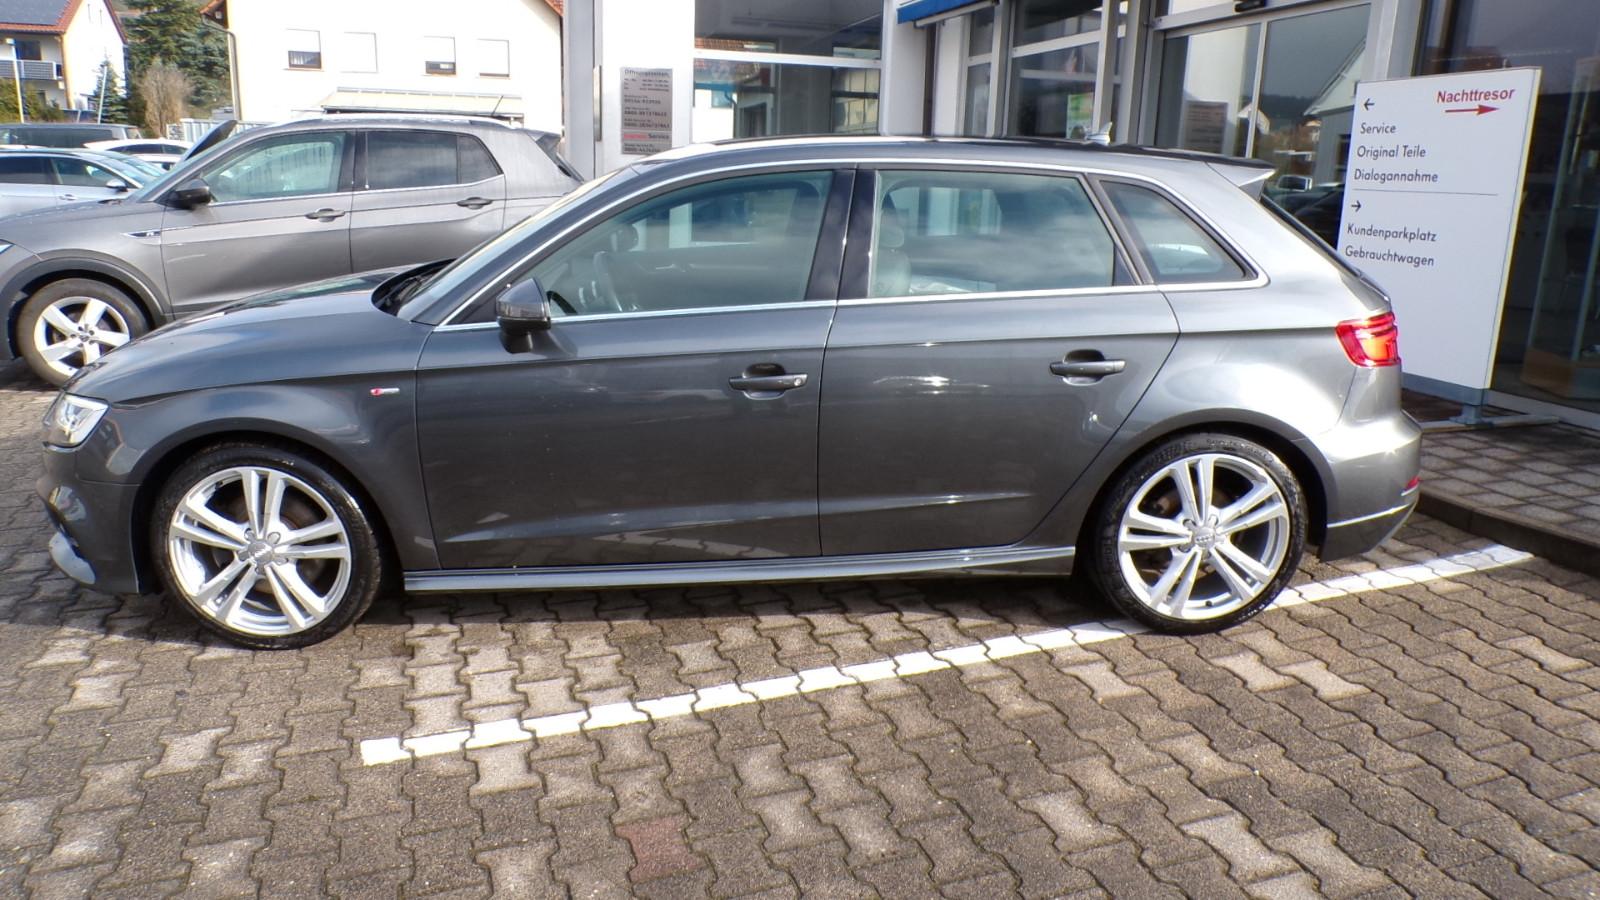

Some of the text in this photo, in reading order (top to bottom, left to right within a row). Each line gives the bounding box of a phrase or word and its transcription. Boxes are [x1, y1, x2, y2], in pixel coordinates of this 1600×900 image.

[1436, 88, 1516, 103] Nachttresor
[1360, 122, 1396, 134] Service
[1357, 144, 1426, 160] Original Teile
[1354, 168, 1438, 183] Dialogannahme
[1347, 223, 1437, 243] Kundenparkplatz
[1345, 245, 1434, 268] Gebrauchtwagen
